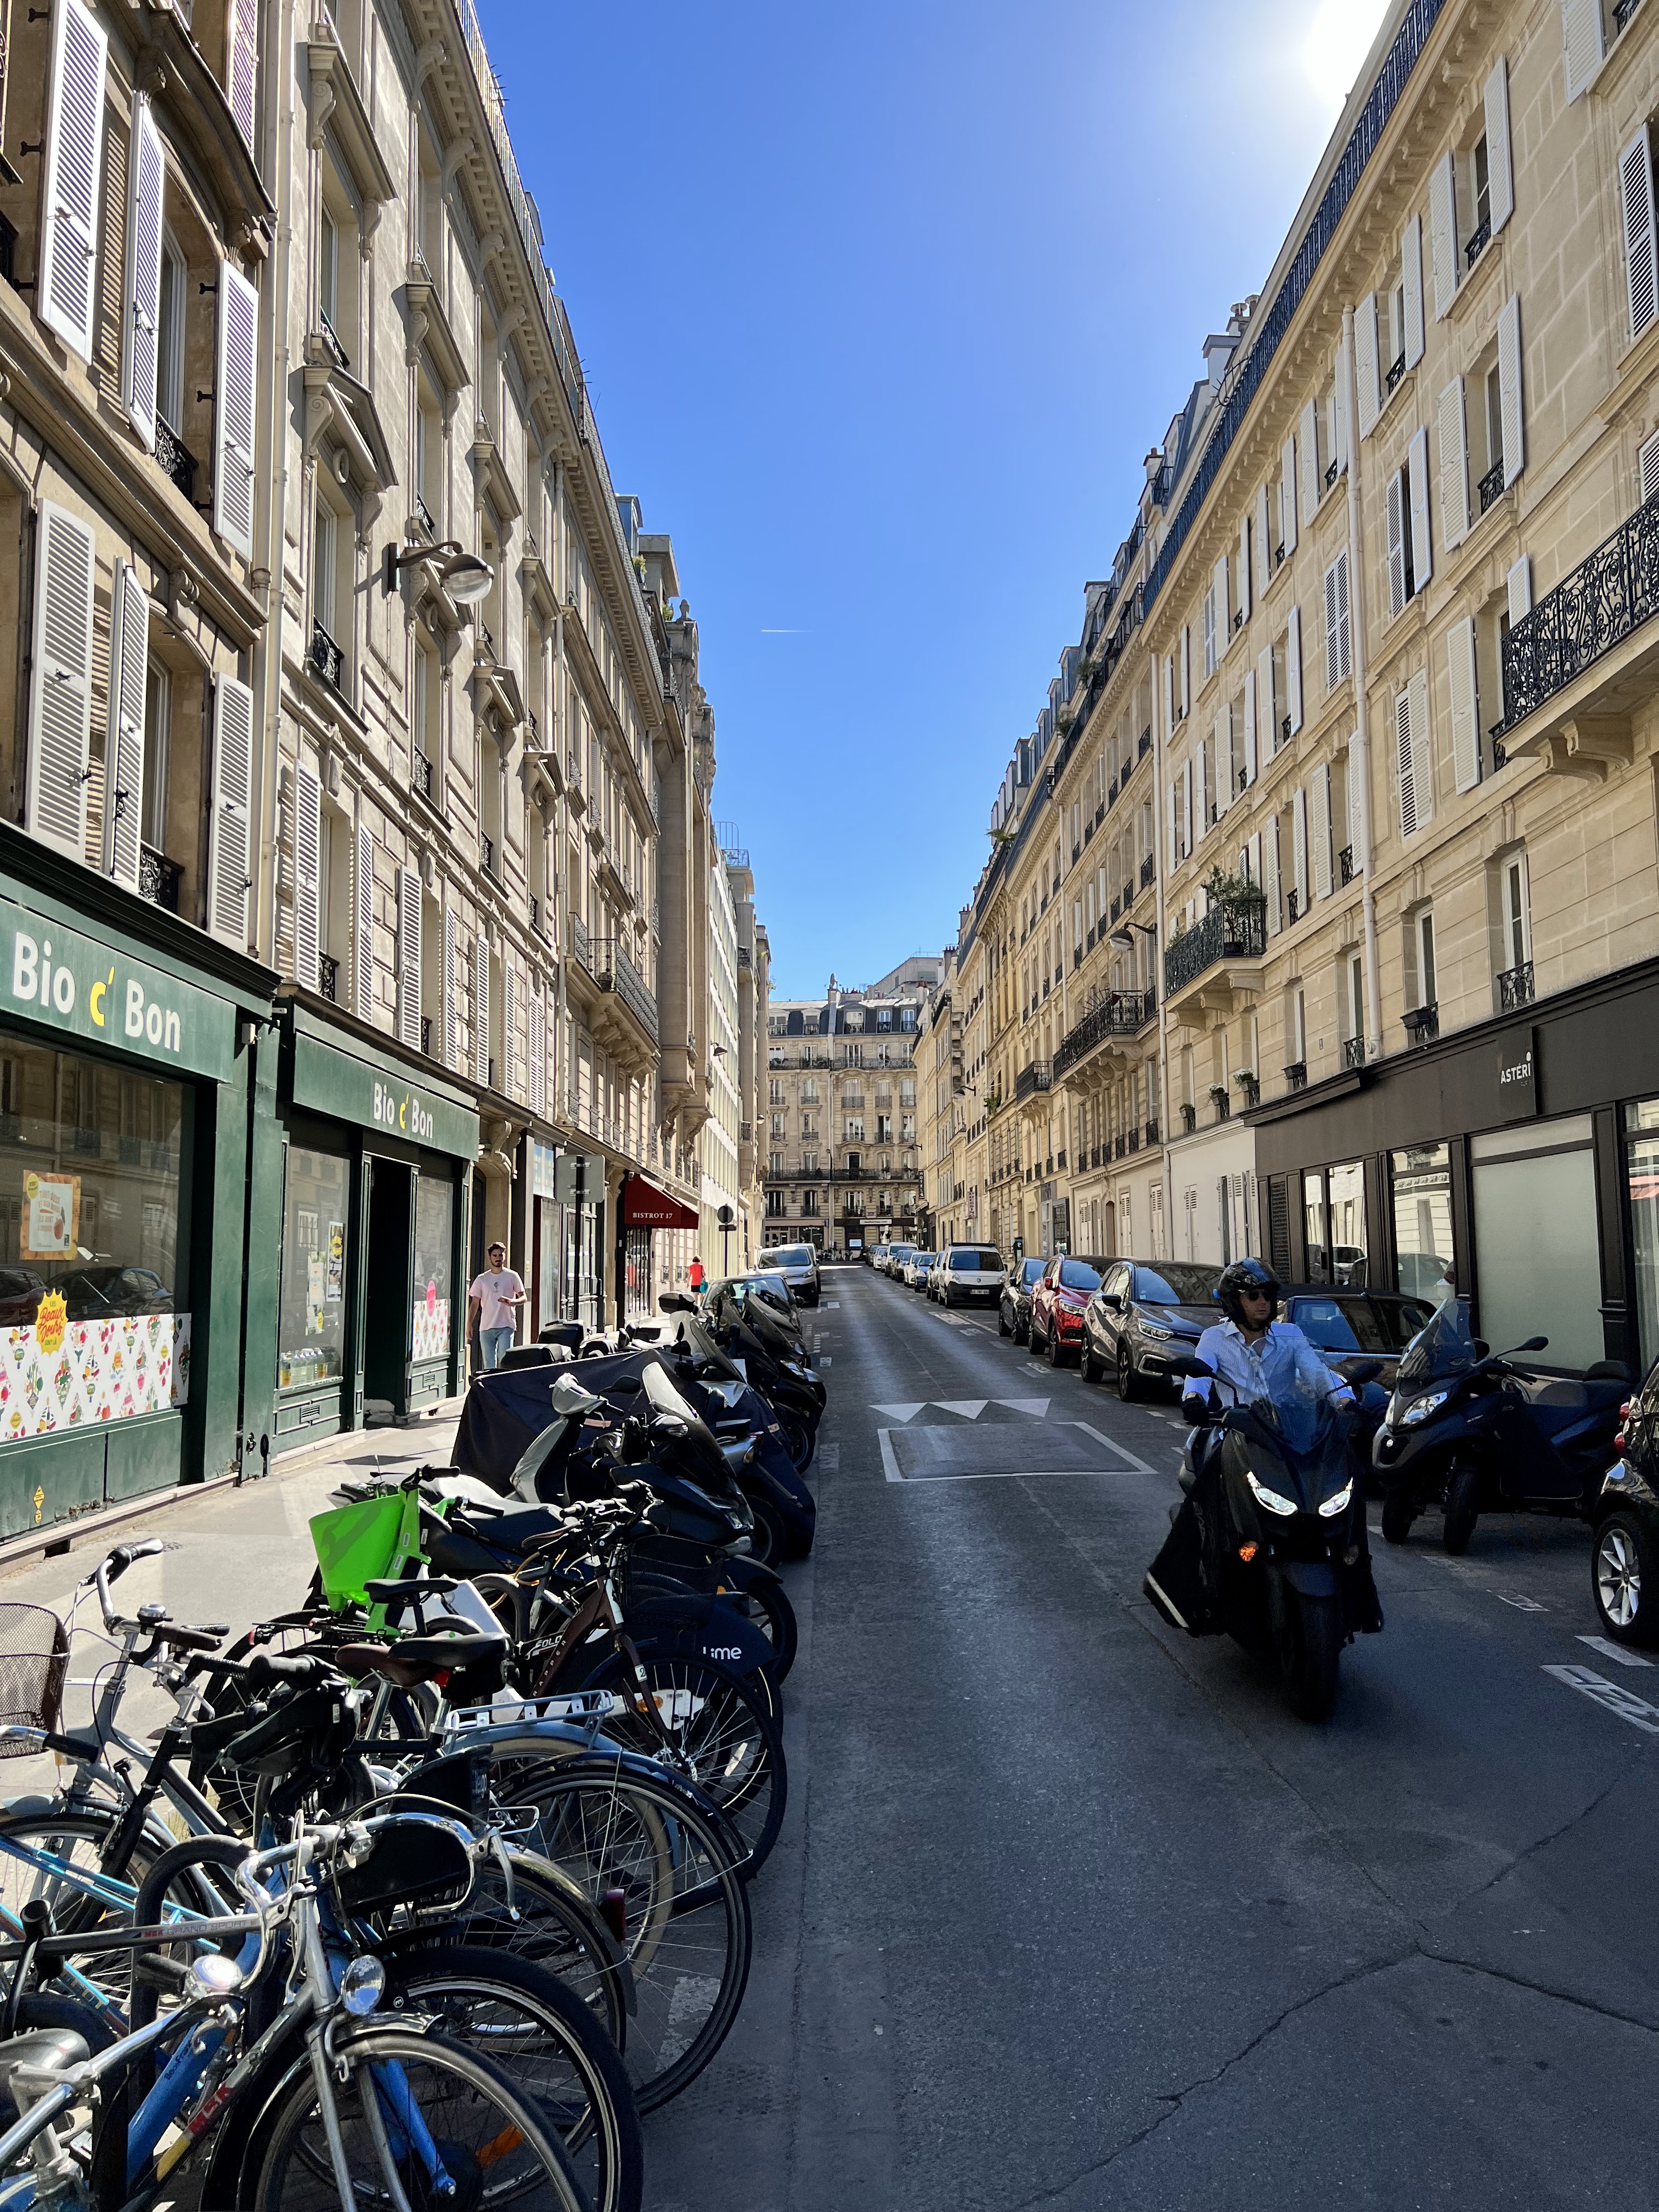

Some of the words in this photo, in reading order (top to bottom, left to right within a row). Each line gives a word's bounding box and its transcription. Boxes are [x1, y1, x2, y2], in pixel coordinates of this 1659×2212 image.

[13, 932, 76, 1014] Bio
[125, 979, 181, 1052] Bon
[373, 1082, 395, 1125] Bio
[411, 1098, 433, 1138] Bon
[38, 1307, 65, 1329] Beaux
[40, 1321, 63, 1342] Jours
[639, 1668, 646, 1677] 2
[166, 1924, 207, 1935] GRAND
[211, 1920, 246, 1931] SPORT
